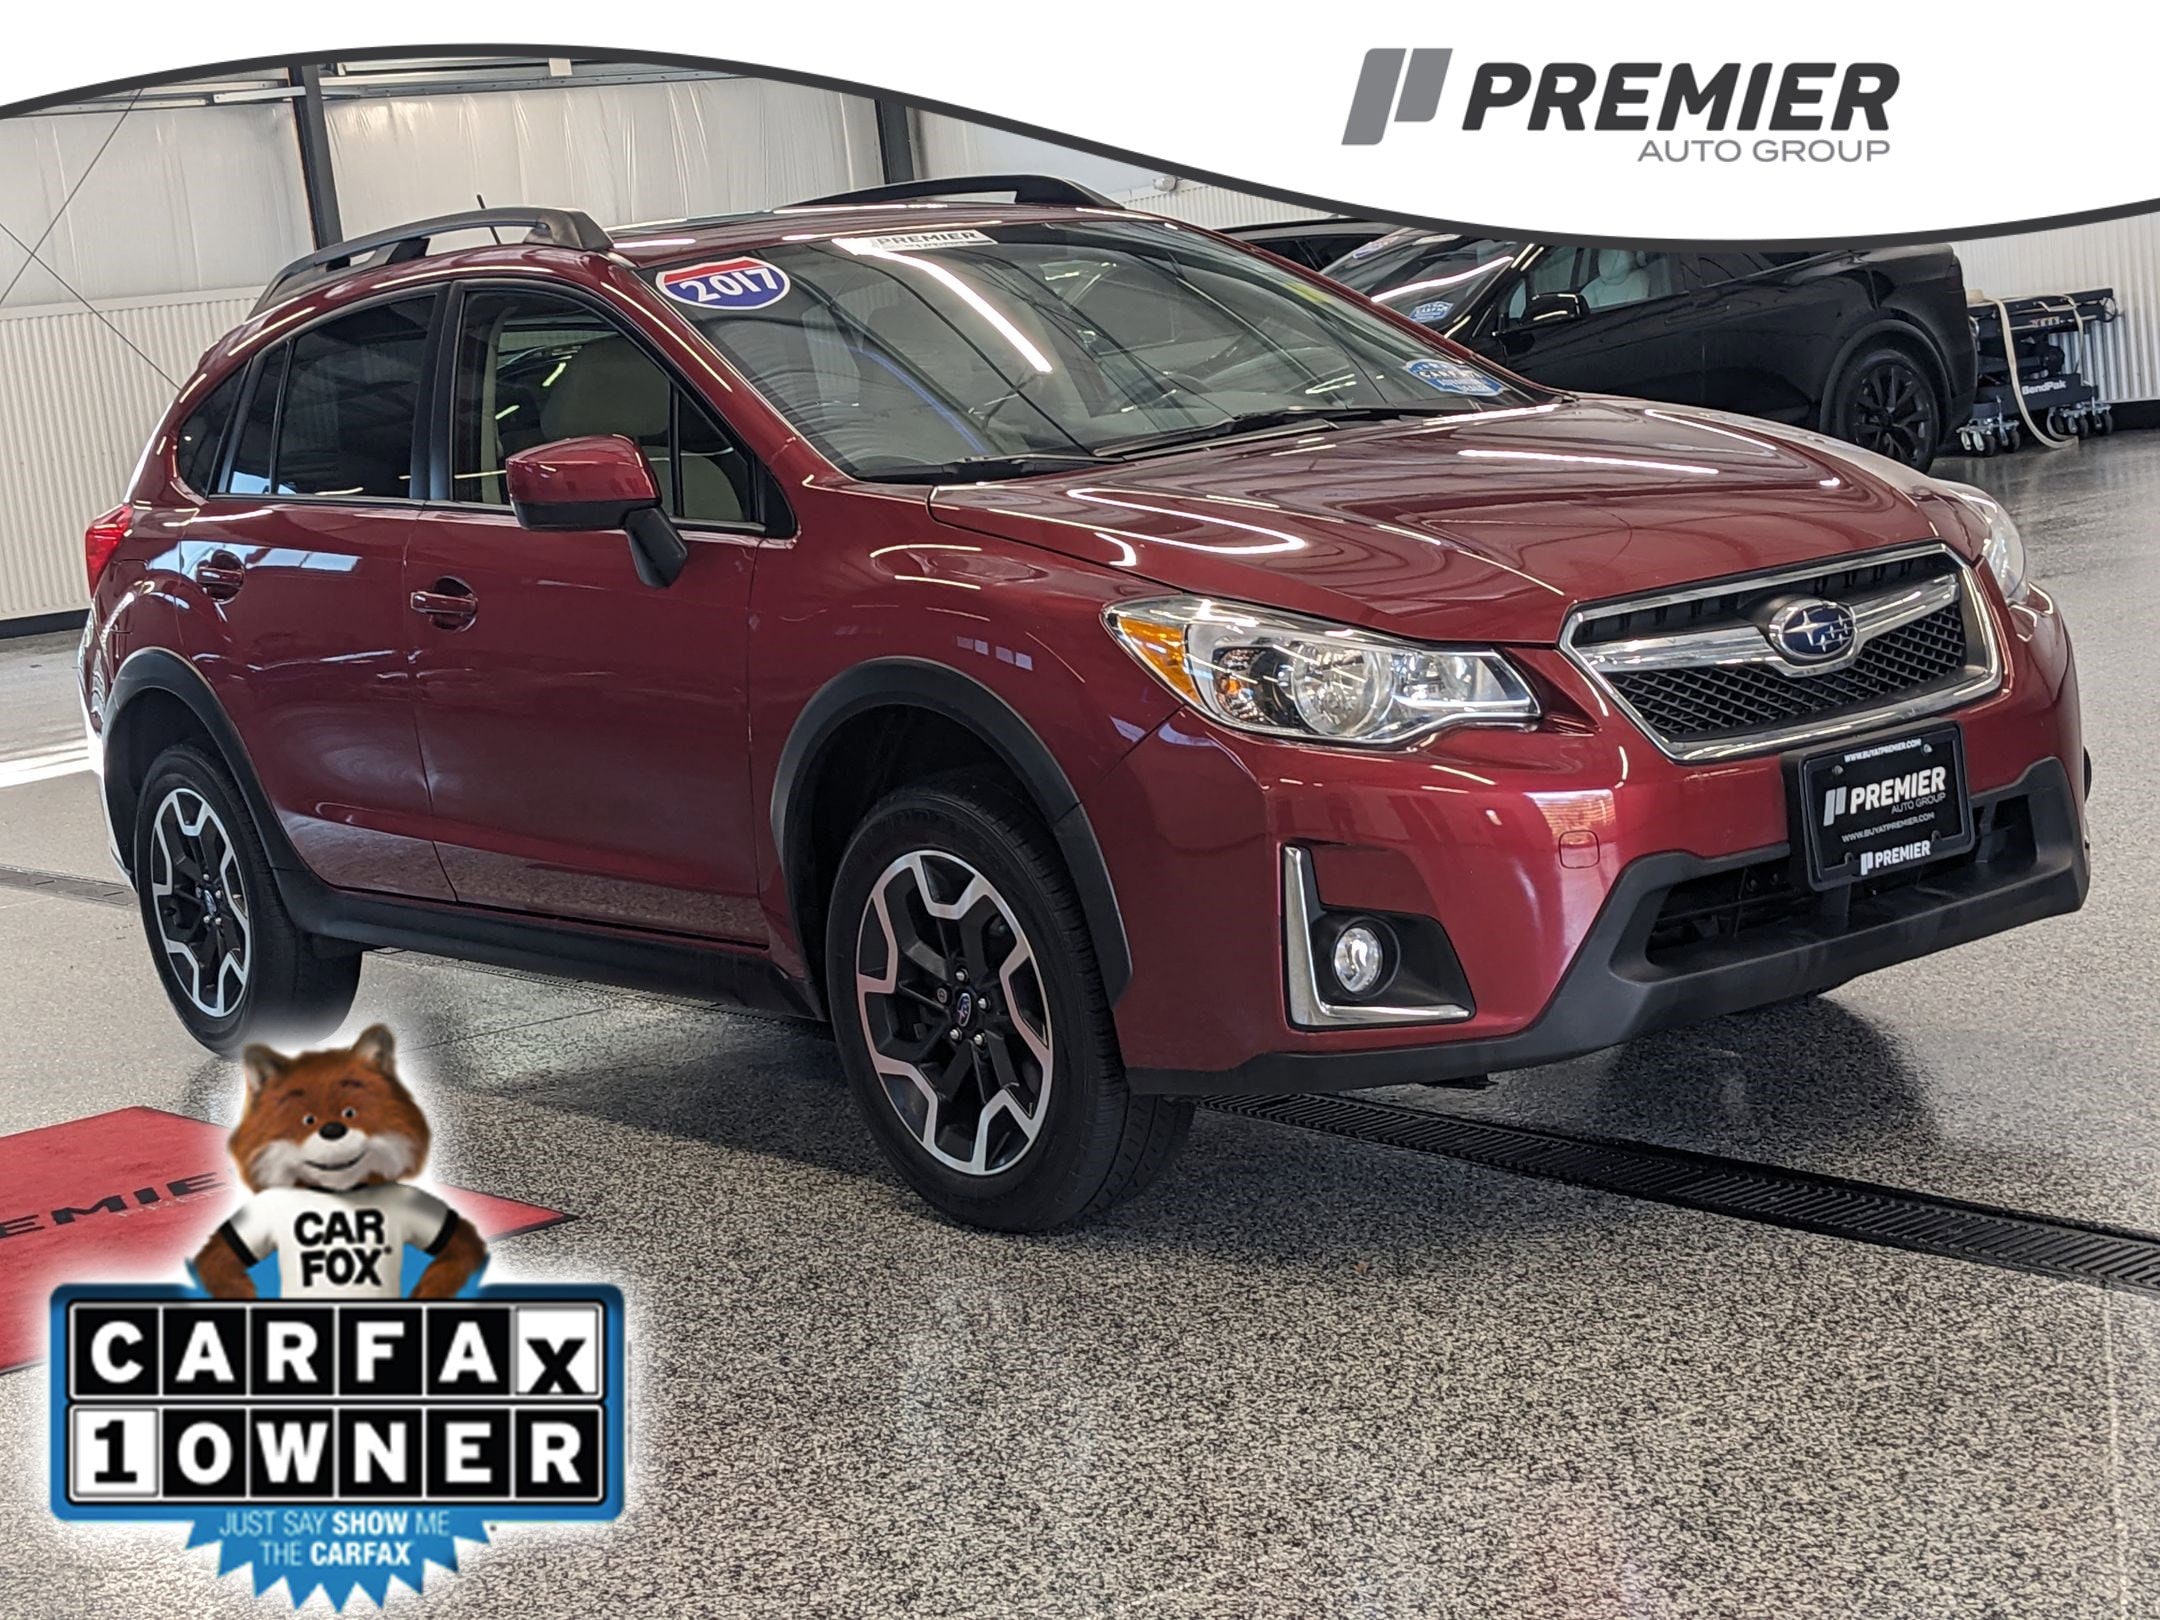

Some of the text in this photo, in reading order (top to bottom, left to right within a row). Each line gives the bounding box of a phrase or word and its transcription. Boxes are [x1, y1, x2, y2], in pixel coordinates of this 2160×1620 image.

[877, 230, 978, 245] PREMIER
[679, 267, 779, 302] 2017
[2021, 379, 2067, 396] BendPak
[1850, 766, 1947, 815] PREMIER
[1890, 792, 1947, 815] AUTO GROUP
[1874, 840, 1932, 868] PREMIER
